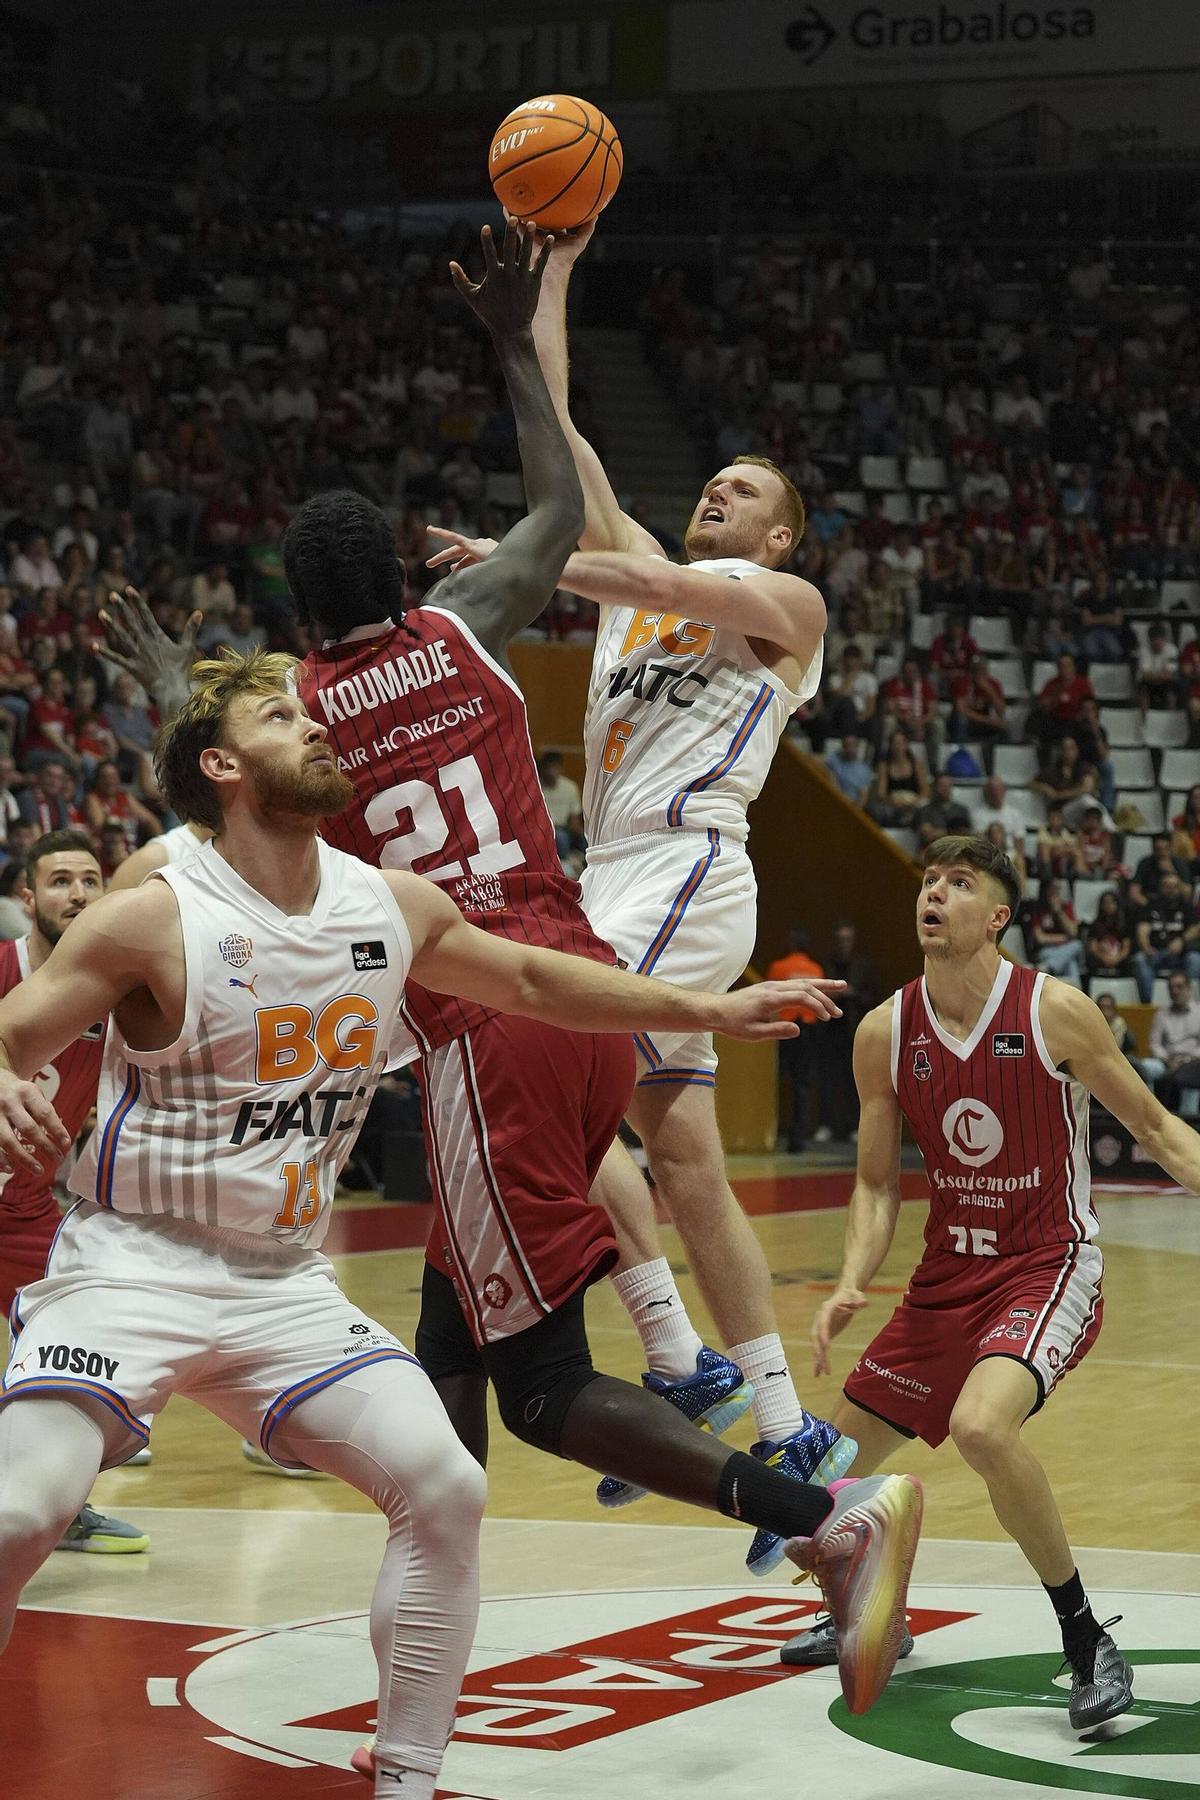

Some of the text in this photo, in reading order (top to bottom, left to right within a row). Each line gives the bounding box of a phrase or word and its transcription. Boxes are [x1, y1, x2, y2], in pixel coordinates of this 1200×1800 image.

[848, 4, 1097, 49] Grabalosa
[492, 129, 527, 162] EVO
[618, 608, 717, 659] BG
[317, 640, 459, 725] KOUMADJE
[607, 663, 710, 708] IATC
[336, 696, 485, 771] AIR HORIZONT
[601, 718, 638, 774] 6
[364, 754, 527, 882] 21
[459, 881, 503, 905] SABOR
[477, 897, 505, 912] VERDAD
[222, 944, 250, 953] BASQUET
[222, 951, 253, 962] GIRONA
[354, 951, 370, 960] liga
[356, 958, 386, 968] endesa
[254, 993, 379, 1086] BG
[995, 1040, 1007, 1049] liga
[271, 1159, 320, 1230] 13
[959, 1193, 1005, 1208] RAGOZA
[38, 1345, 120, 1381] YOSOY
[865, 1358, 932, 1394] azumarino
[888, 1382, 904, 1395] new
